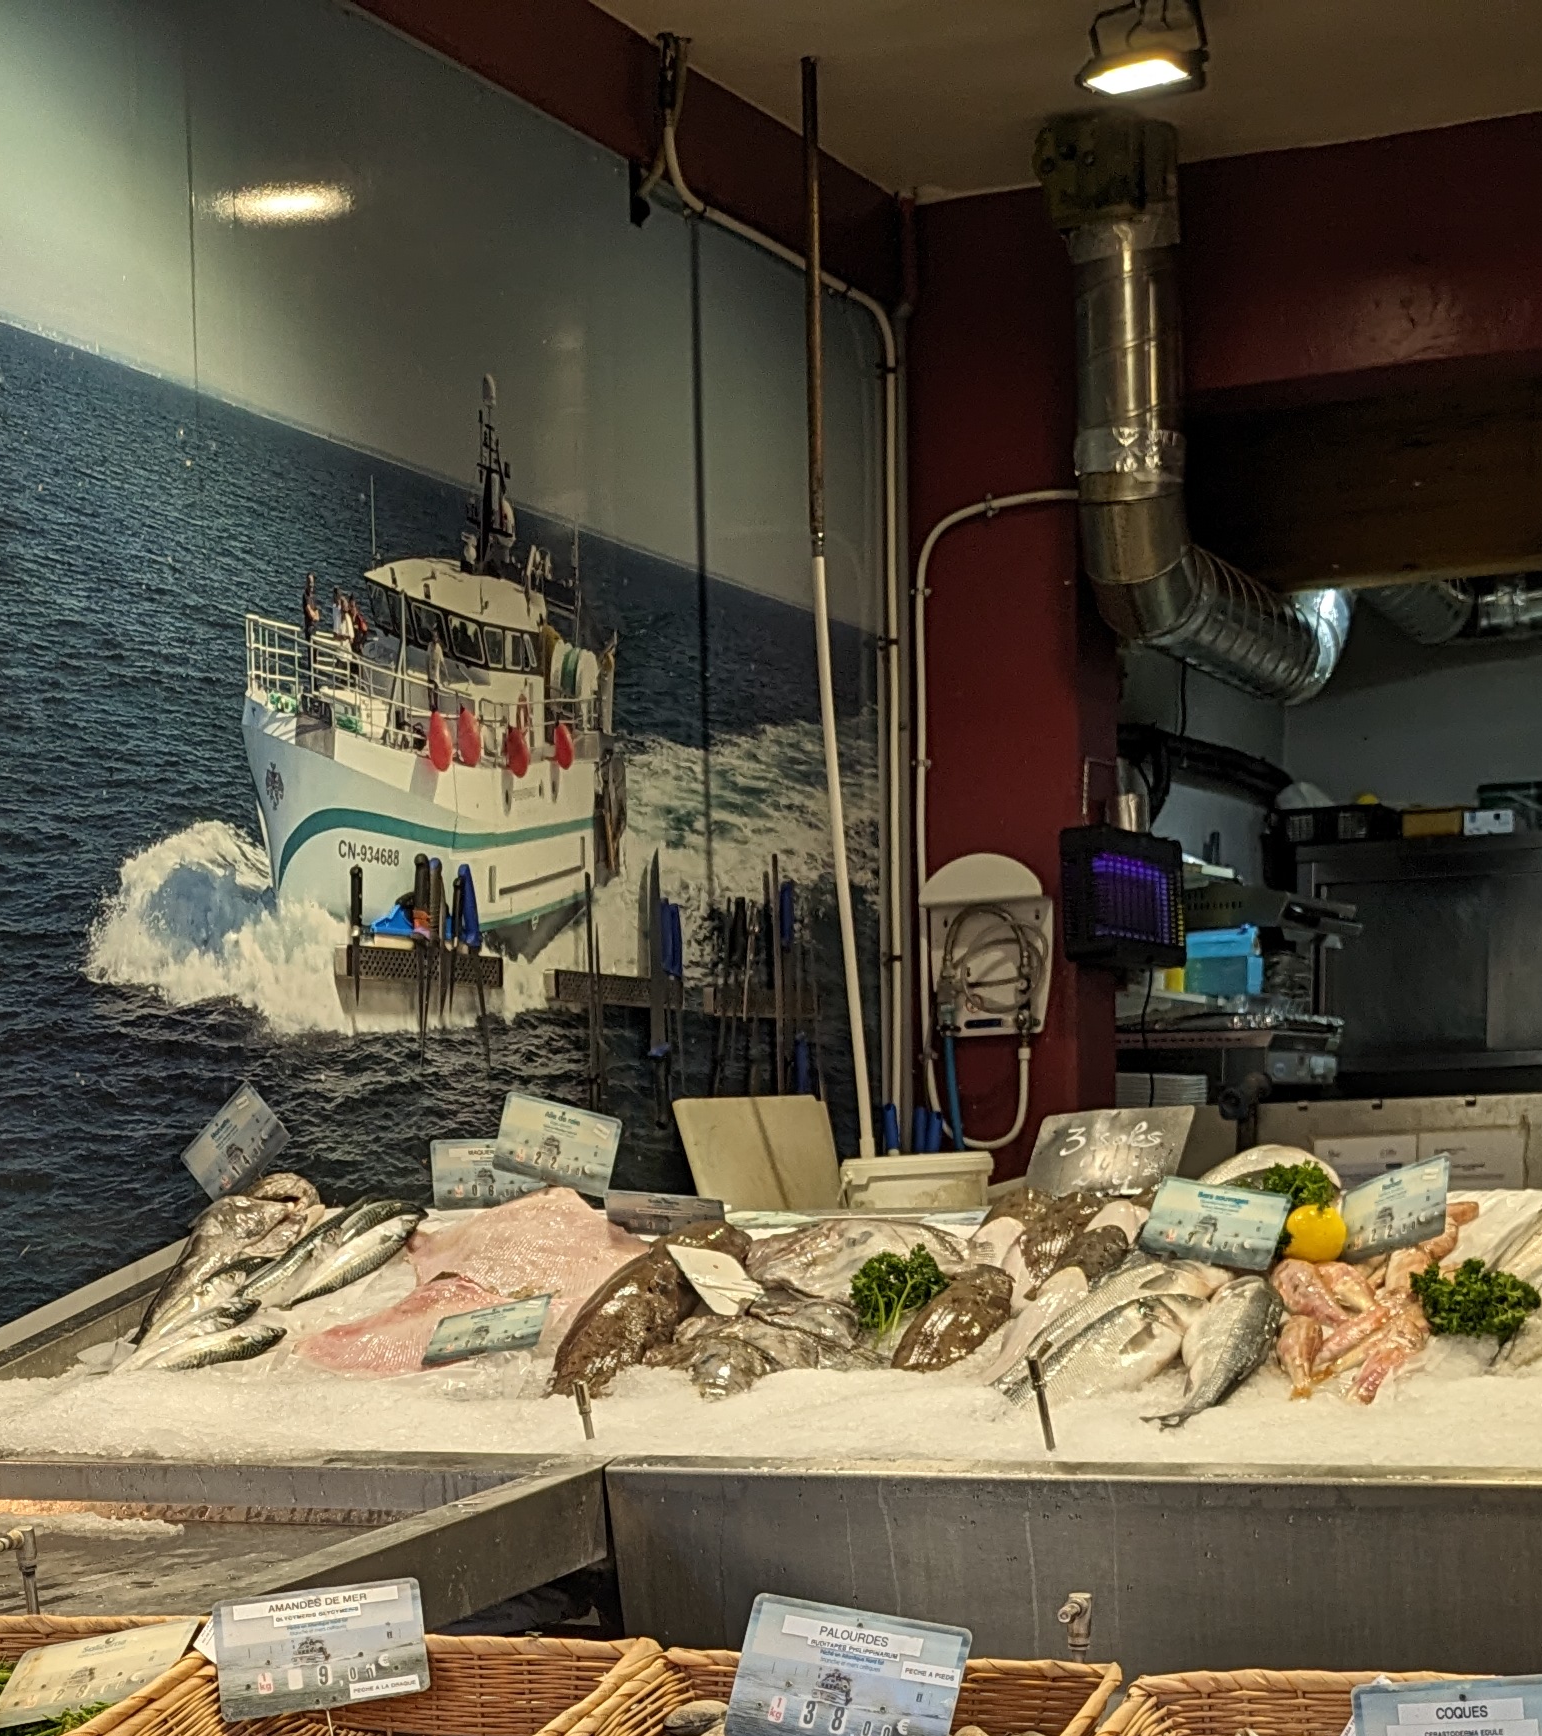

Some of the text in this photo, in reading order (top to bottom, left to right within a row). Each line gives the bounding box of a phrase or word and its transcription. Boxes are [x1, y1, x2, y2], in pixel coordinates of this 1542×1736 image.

[338, 839, 400, 868] CN-934688
[1059, 1126, 1087, 1158] 3
[268, 1592, 367, 1614] AMANDES DE MER
[819, 1625, 890, 1648] PALOURDES
[258, 1682, 272, 1692] kg
[768, 1707, 783, 1721] kg
[1435, 1705, 1489, 1720] COQUES
[1480, 1728, 1505, 1736] EDULE
